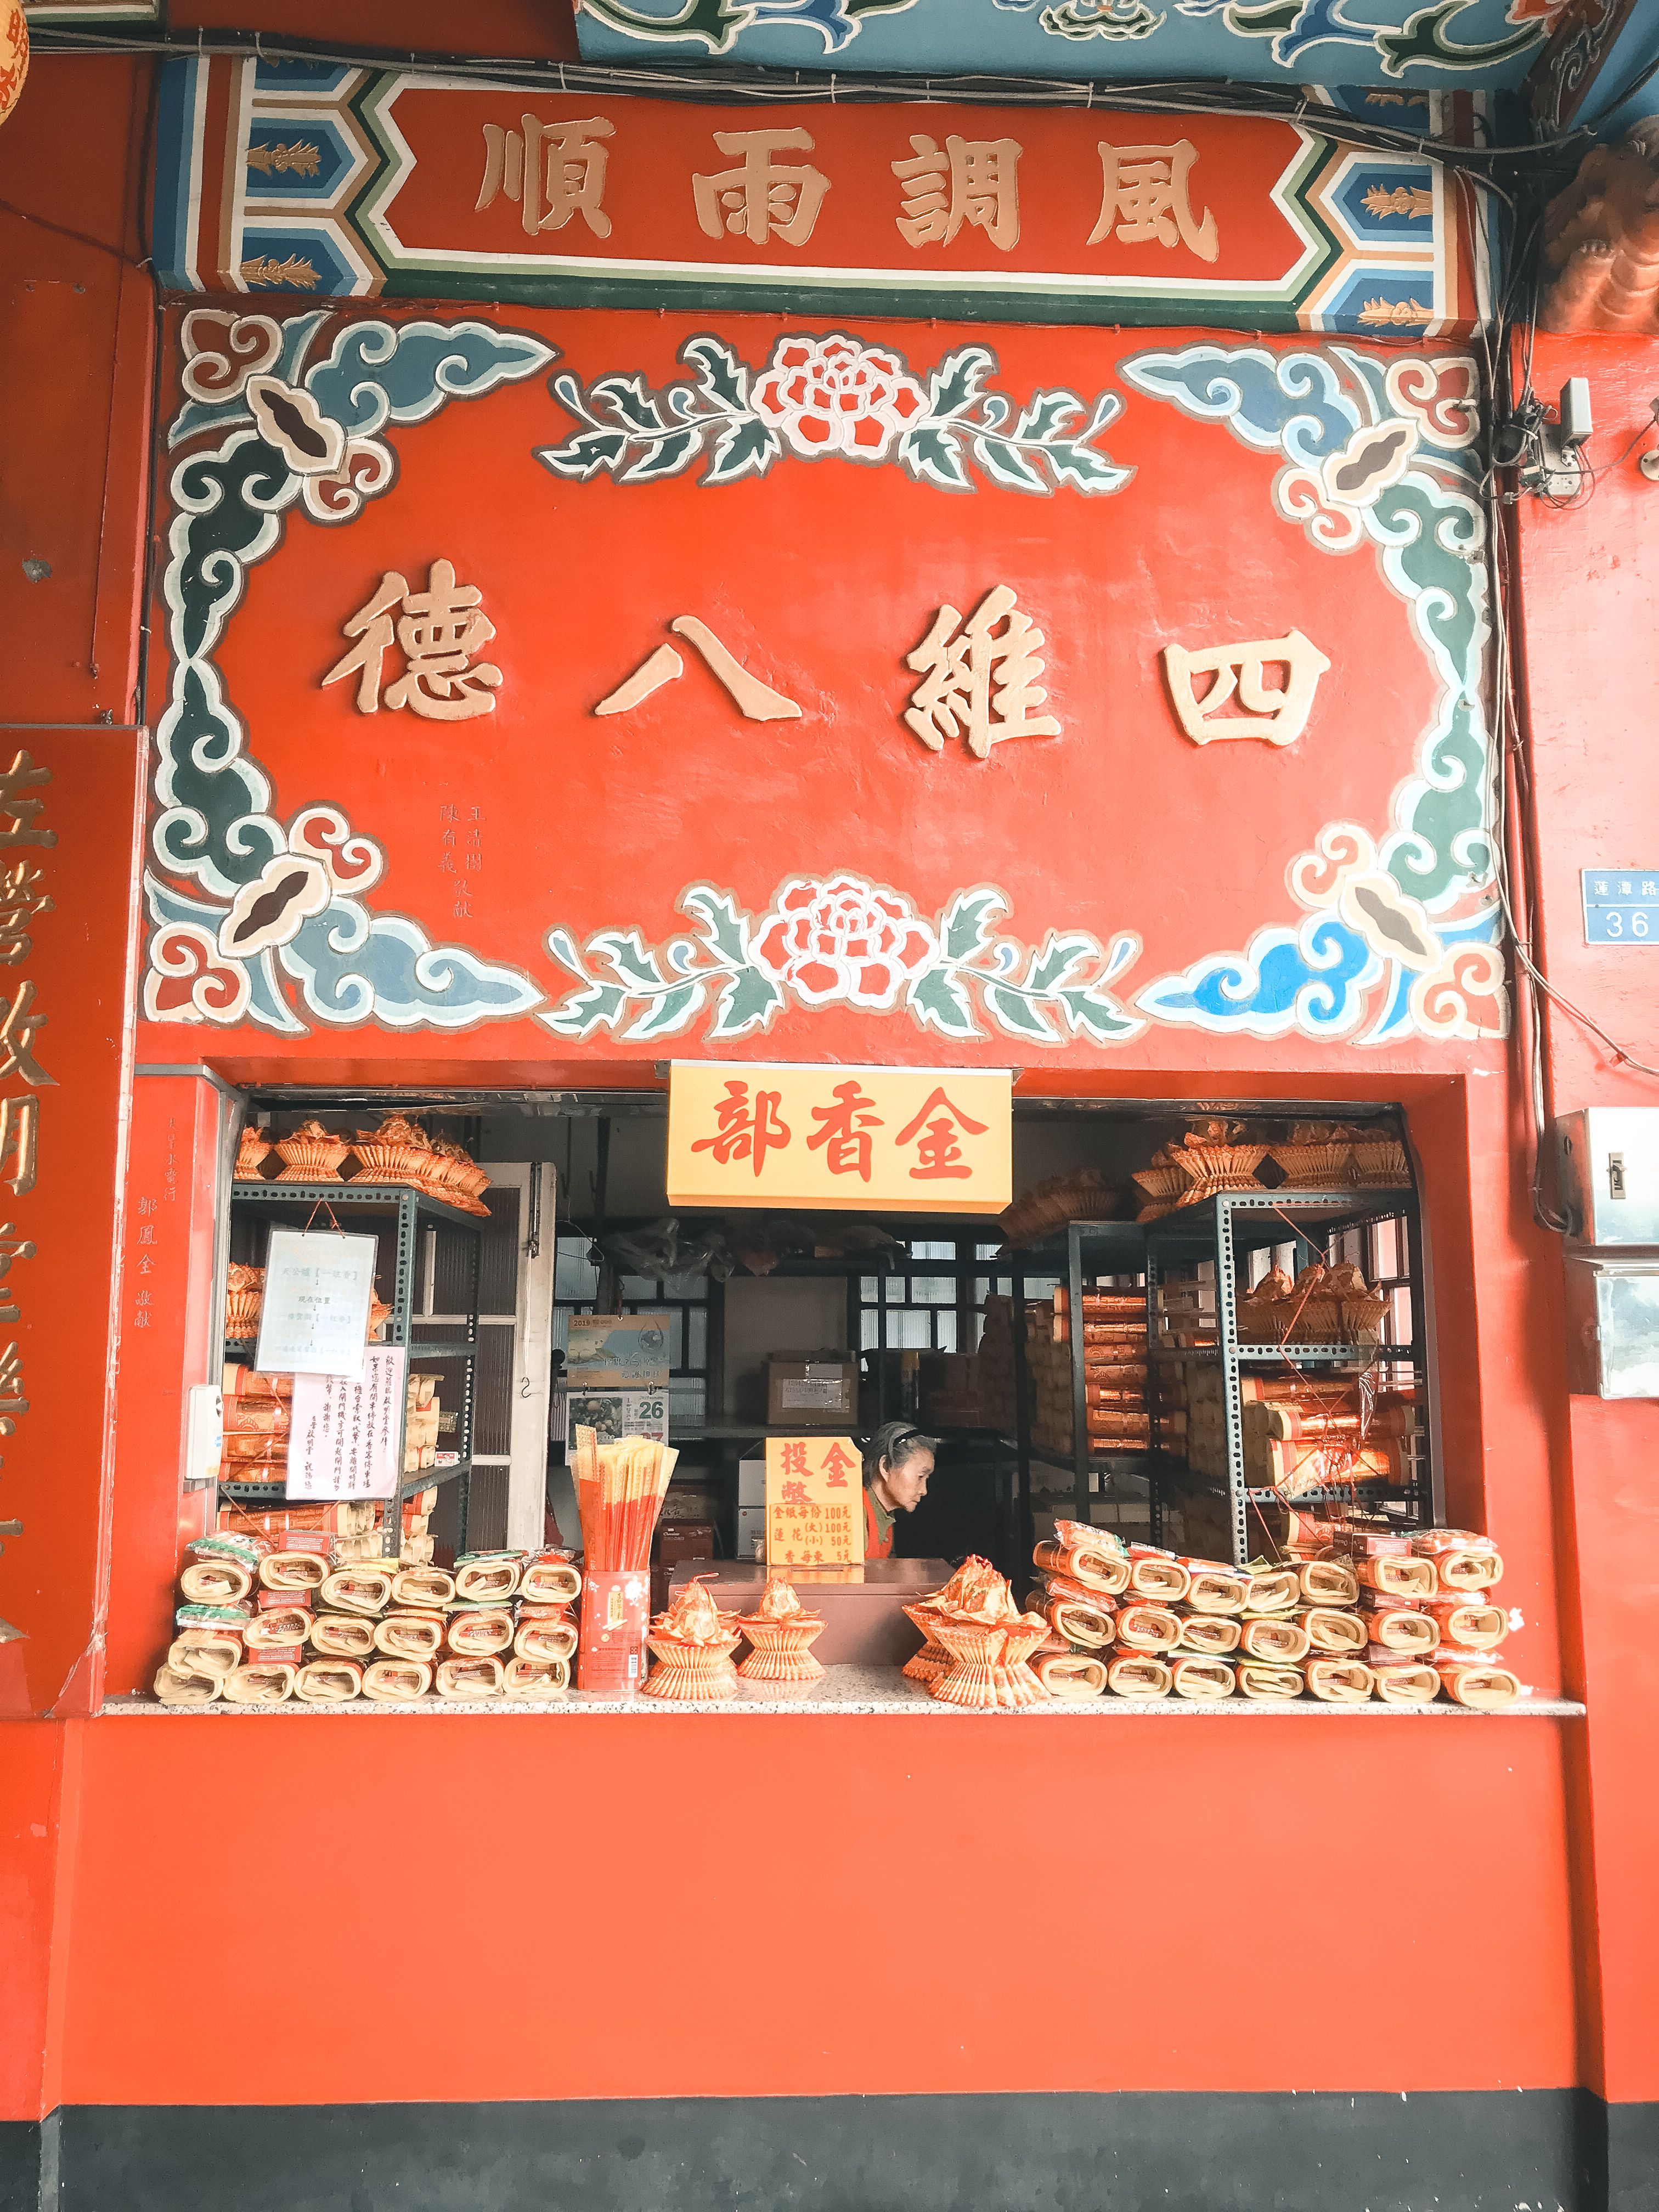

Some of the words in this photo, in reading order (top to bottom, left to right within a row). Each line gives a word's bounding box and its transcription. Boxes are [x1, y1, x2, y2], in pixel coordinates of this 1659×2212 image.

[475, 114, 1219, 262] 風調雨順
[321, 558, 1331, 758] 四維八德
[1594, 881, 1656, 896] 蓮潭路
[1606, 911, 1649, 938] 36
[691, 1080, 989, 1183] 金香部
[298, 1296, 331, 1304] 現在位置
[639, 1402, 663, 1419] 26
[774, 1506, 822, 1519] 金紙每份
[825, 1505, 851, 1519] 100元
[825, 1522, 851, 1533] 100元
[831, 1535, 852, 1546] 50元
